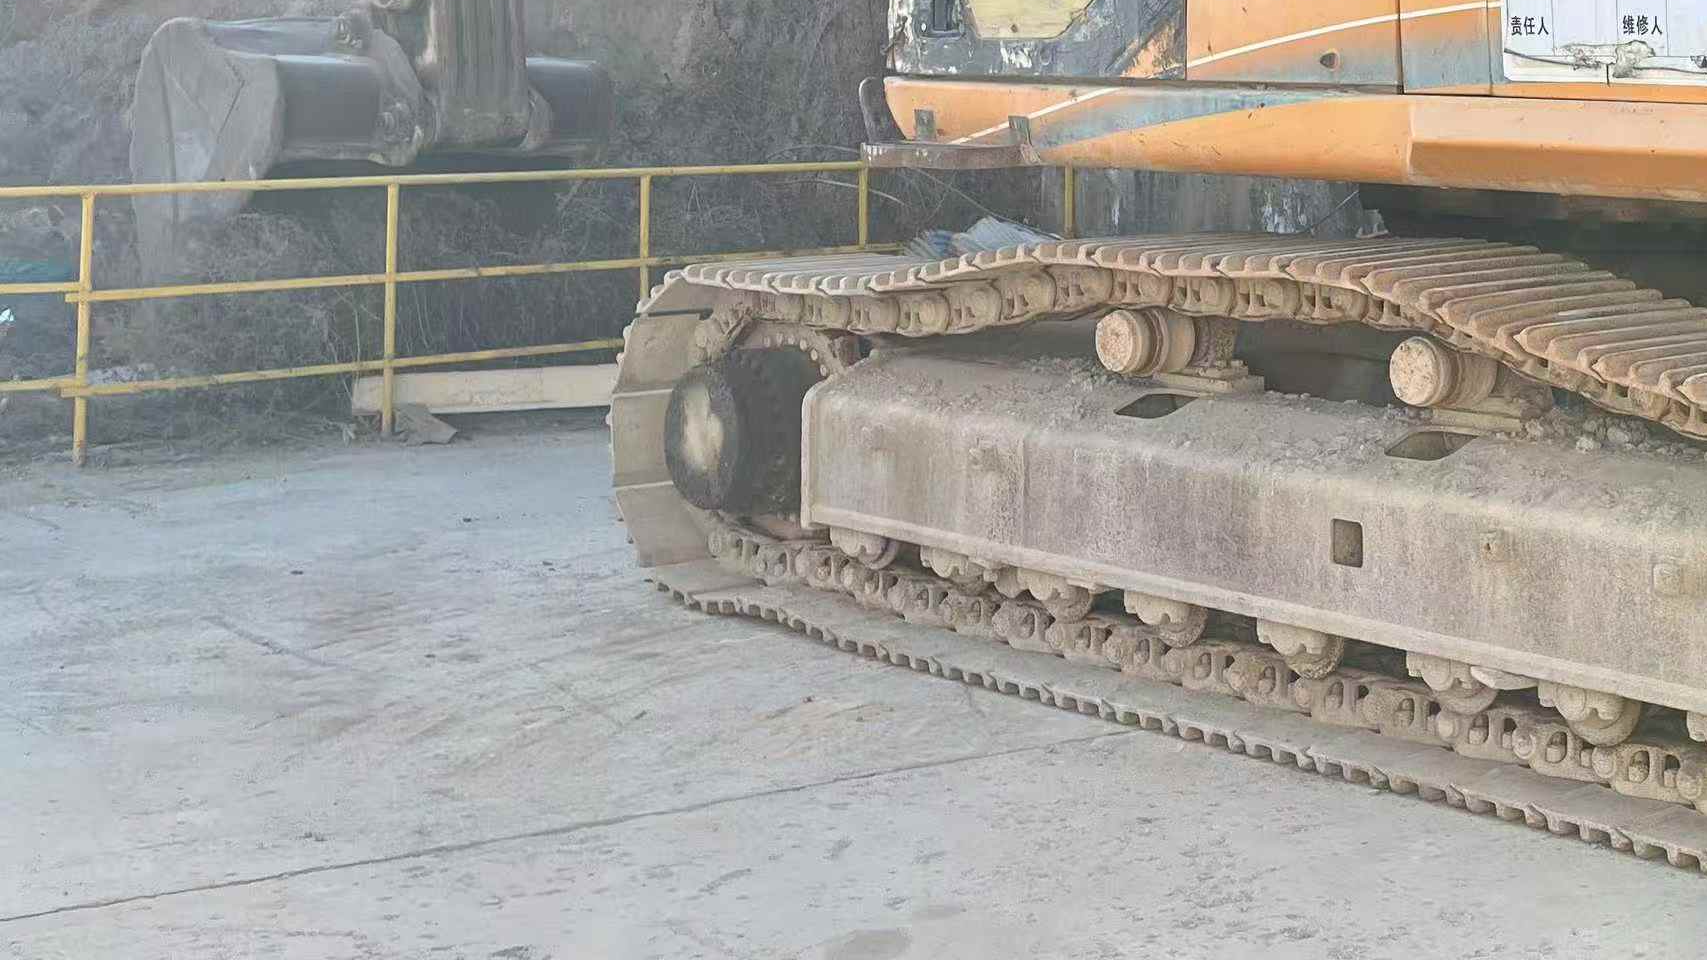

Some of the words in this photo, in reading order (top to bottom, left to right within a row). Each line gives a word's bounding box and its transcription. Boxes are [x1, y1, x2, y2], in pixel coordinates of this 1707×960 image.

[1511, 16, 1549, 36] 责任人
[1623, 16, 1662, 36] 维修人
